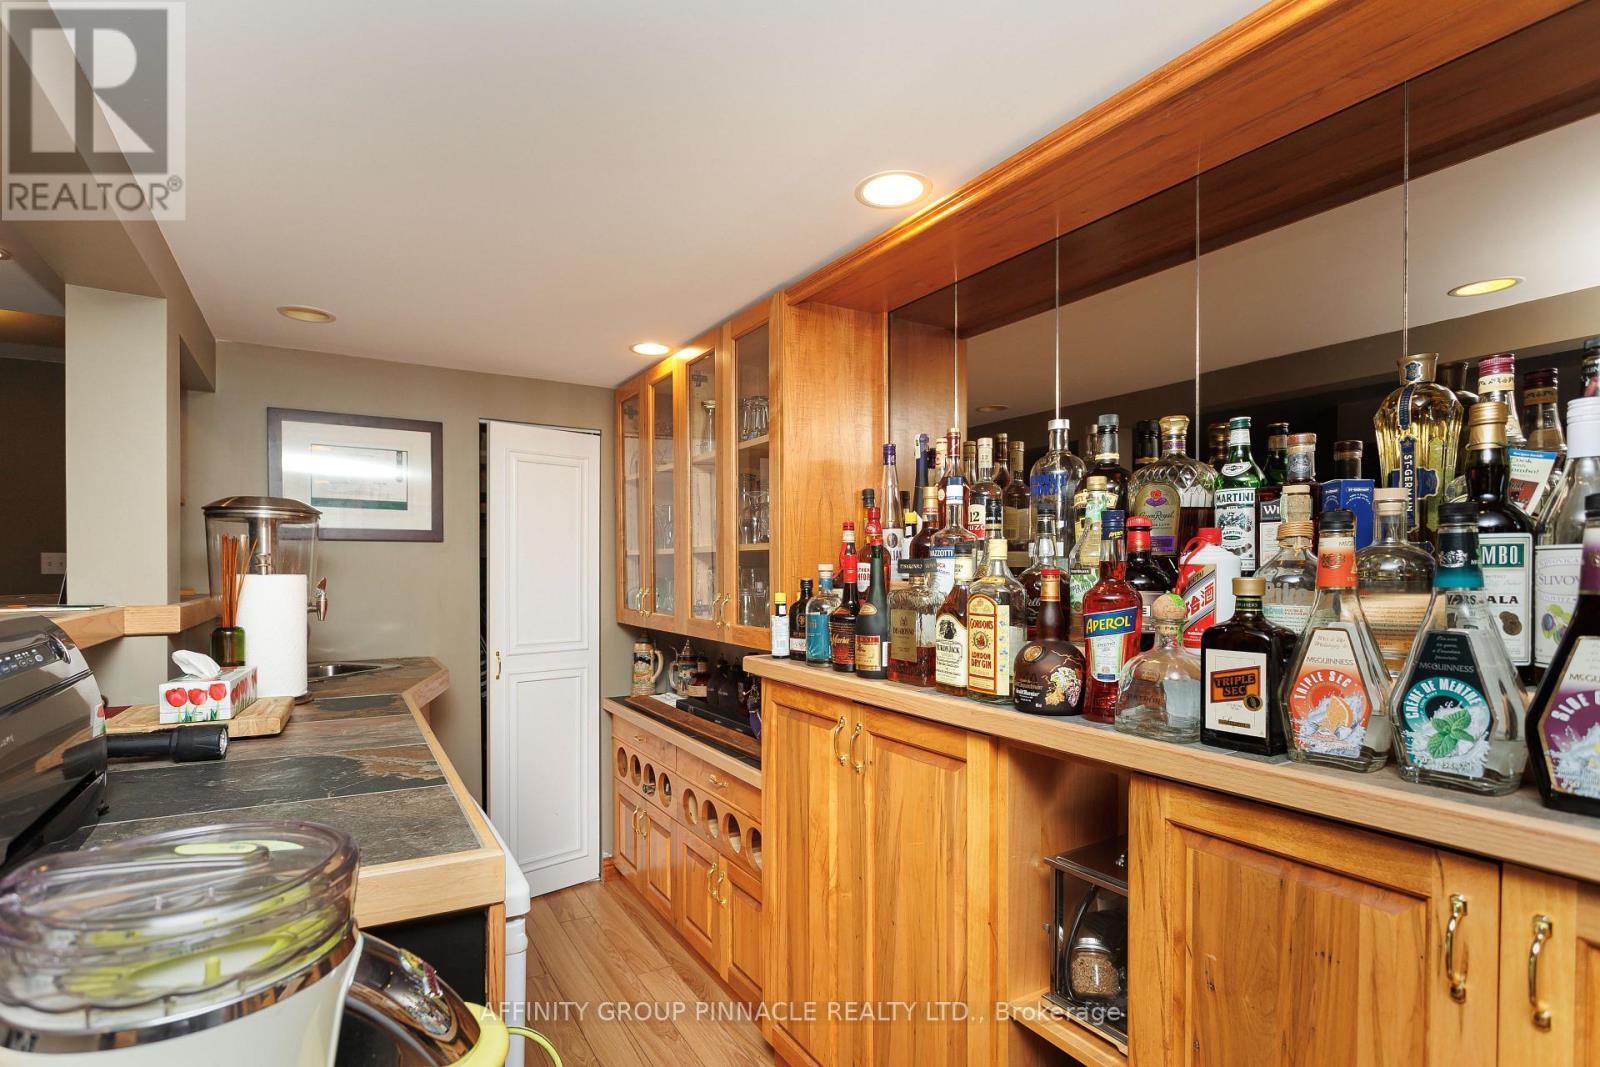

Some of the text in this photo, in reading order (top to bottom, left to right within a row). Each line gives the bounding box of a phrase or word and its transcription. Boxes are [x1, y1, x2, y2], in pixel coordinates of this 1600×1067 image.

[1216, 492, 1254, 503] MARTINI
[1086, 616, 1132, 634] APEROL
[971, 651, 991, 661] LONDON
[971, 659, 992, 669] DRY GIN
[1215, 673, 1255, 687] TRIPLE
[1294, 670, 1352, 700] TRIPLE SEC
[1223, 685, 1247, 697] SEC
[1420, 680, 1437, 694] DE
[1439, 678, 1482, 705] MENTHE
[1551, 693, 1590, 722] SLOE
